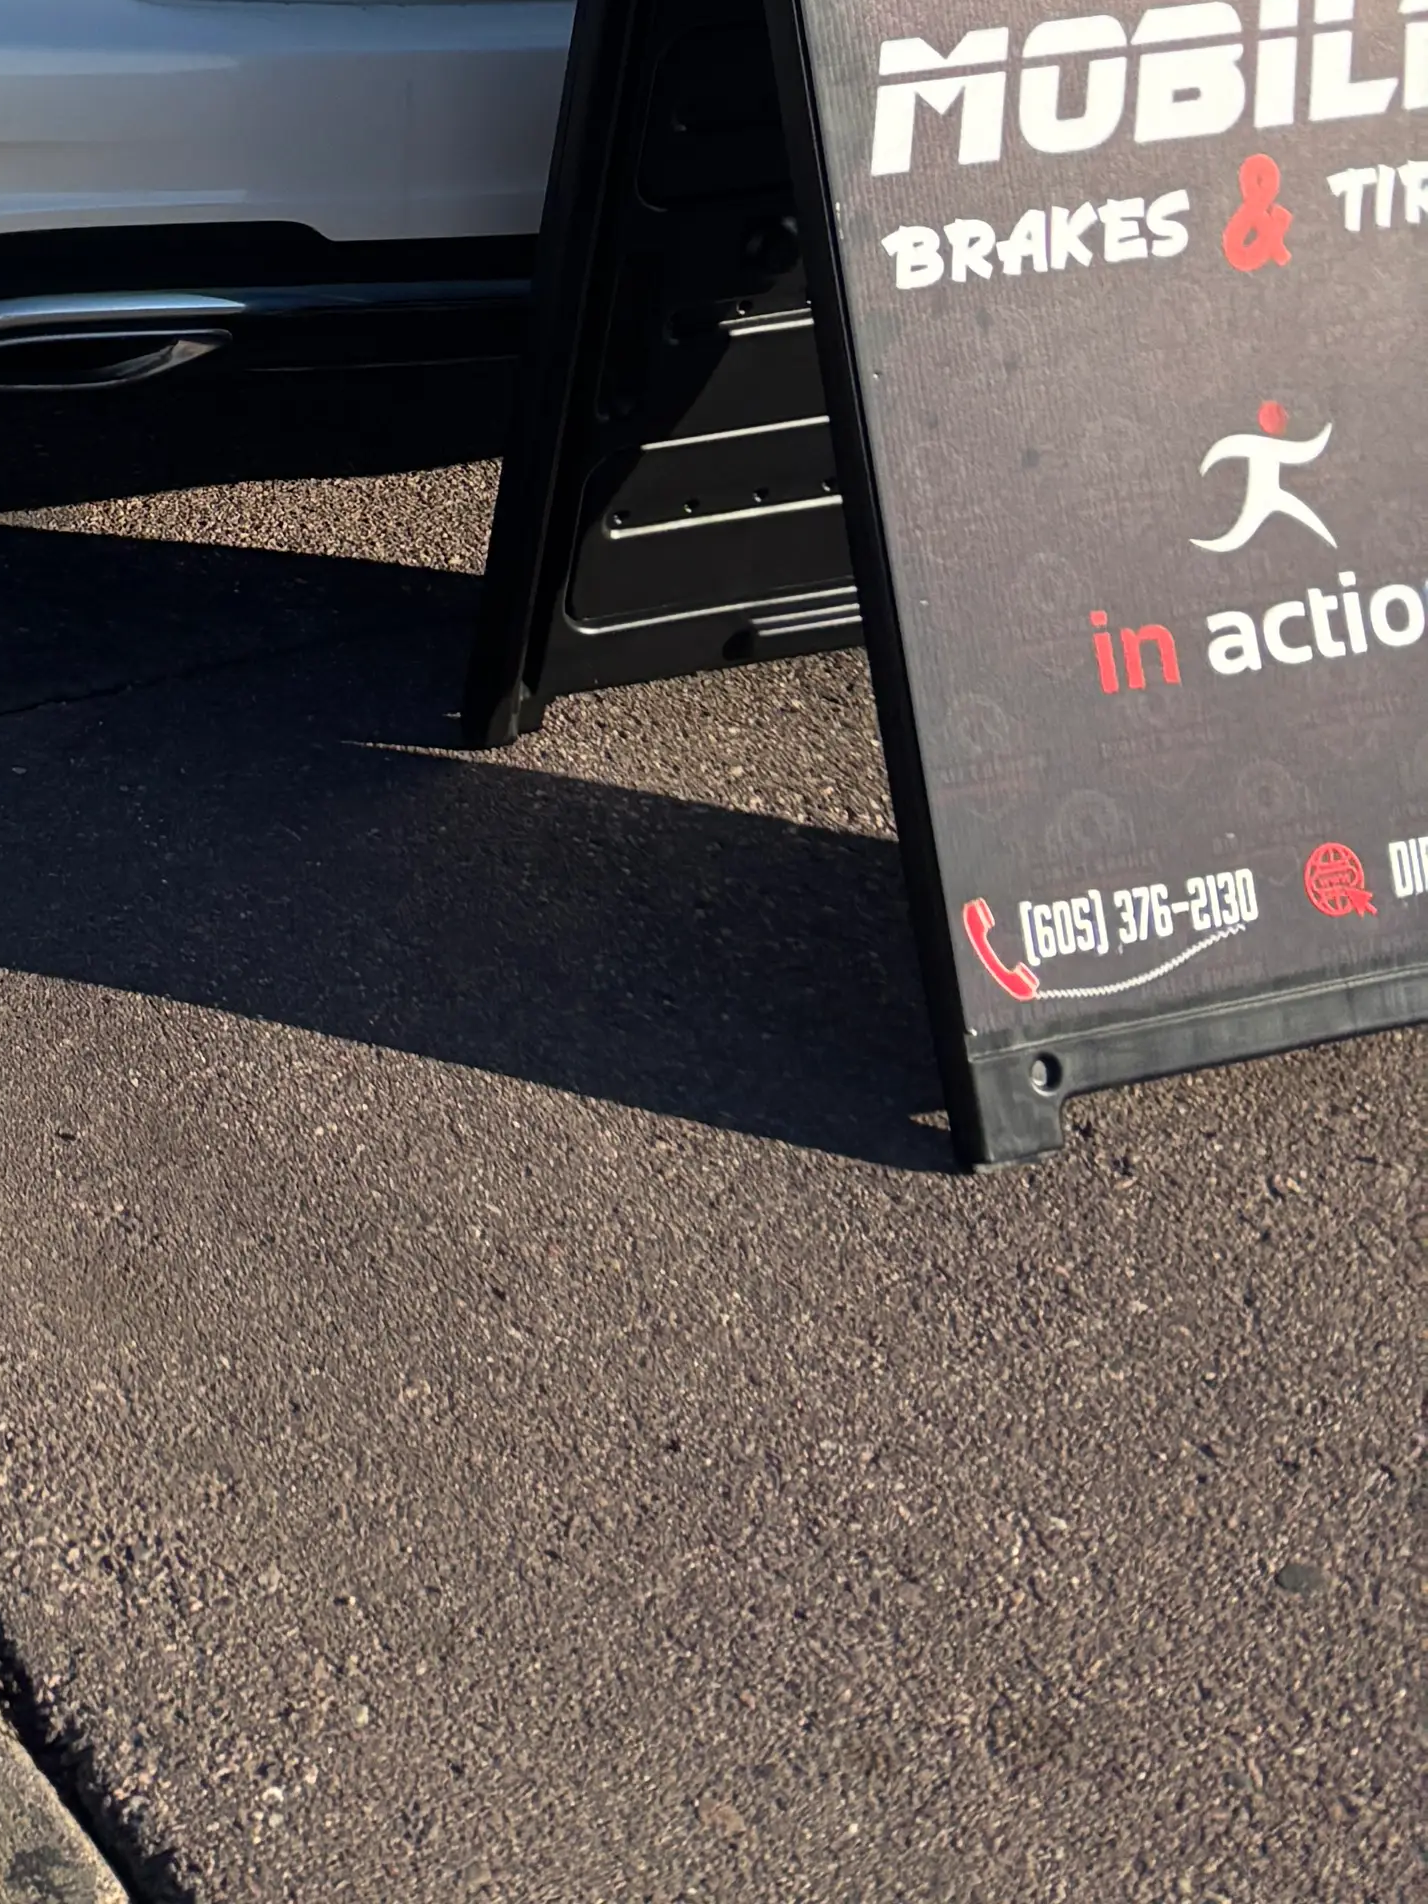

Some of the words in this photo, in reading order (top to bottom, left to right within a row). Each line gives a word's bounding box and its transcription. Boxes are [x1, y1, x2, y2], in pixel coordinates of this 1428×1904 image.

[881, 189, 1191, 290] BRAKES
[1222, 153, 1293, 272] &
[1089, 609, 1182, 695] in
[1205, 570, 1428, 675] actio
[1113, 867, 1260, 944] 376-2130
